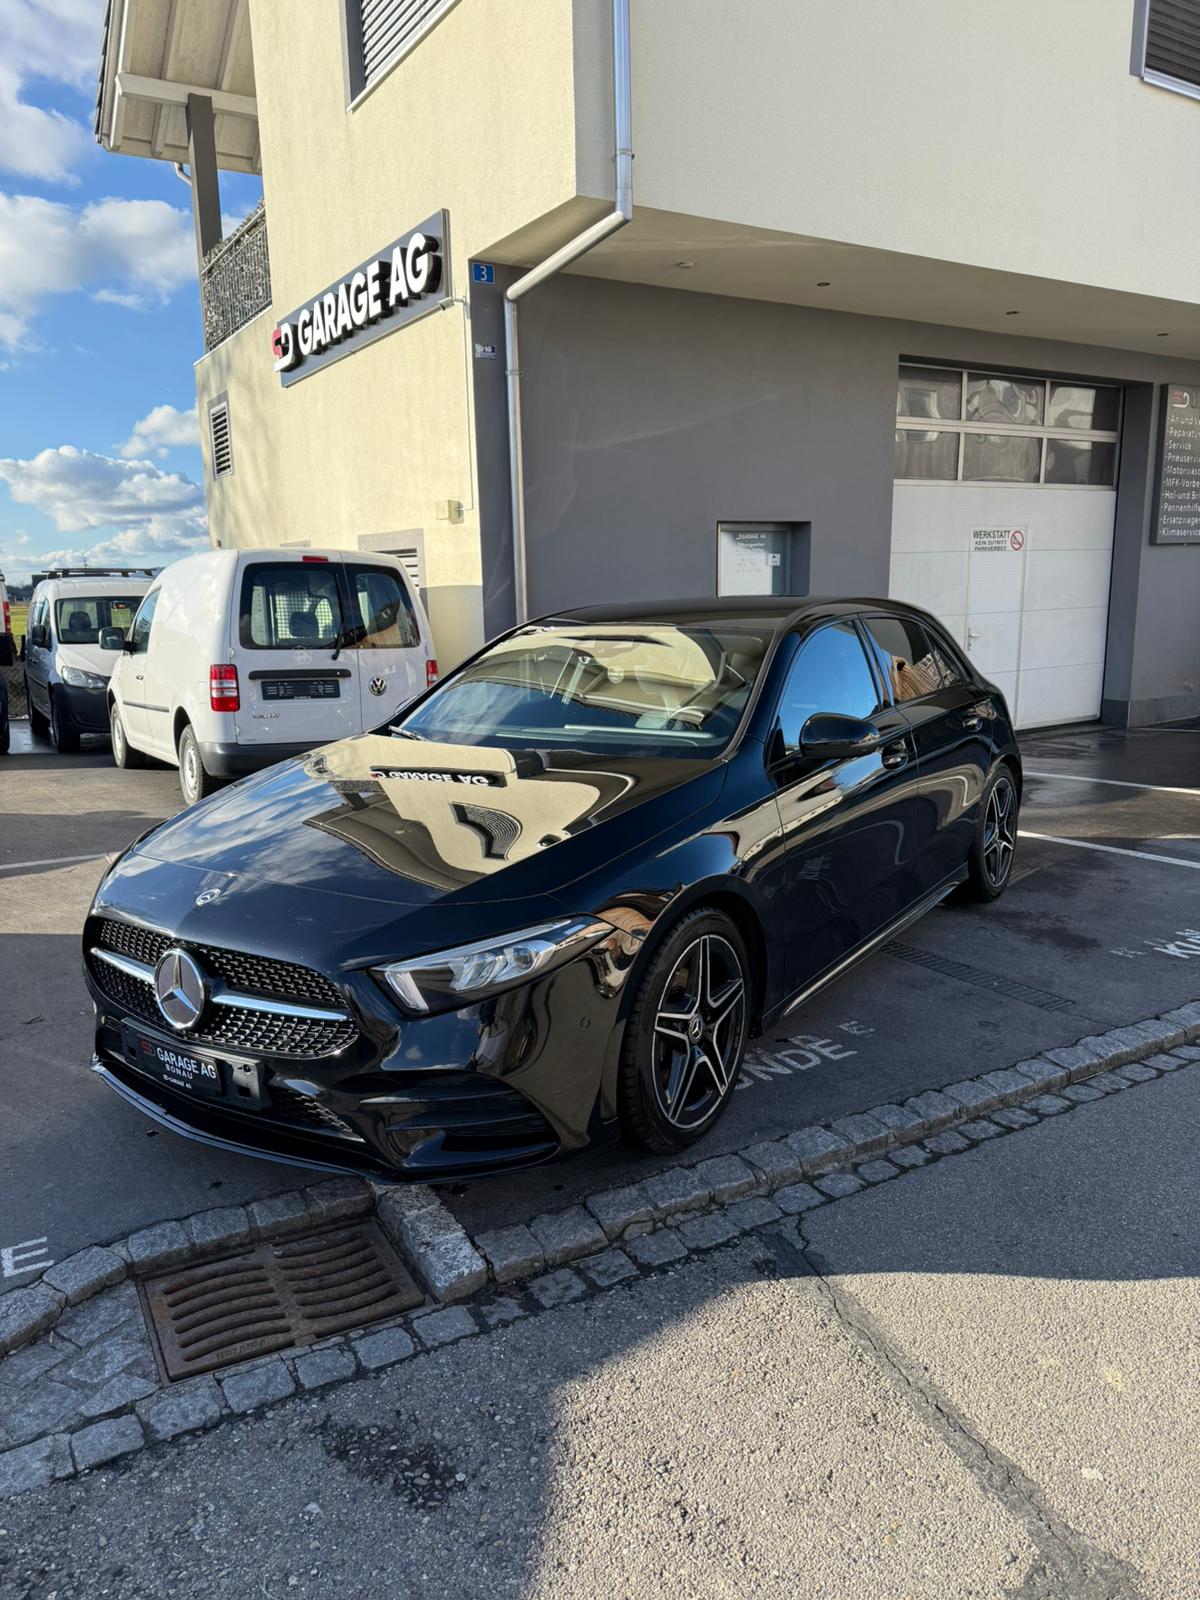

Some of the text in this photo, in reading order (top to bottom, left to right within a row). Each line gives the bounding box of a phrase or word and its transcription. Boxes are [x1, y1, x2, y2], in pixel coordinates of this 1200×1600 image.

[480, 265, 487, 281] 3
[298, 260, 382, 355] GARAGE
[389, 232, 429, 307] AG
[972, 530, 1012, 539] WERKSTATT
[156, 1047, 199, 1074] GARAGE
[201, 1062, 217, 1079] AG
[165, 1063, 193, 1080] BONAU
